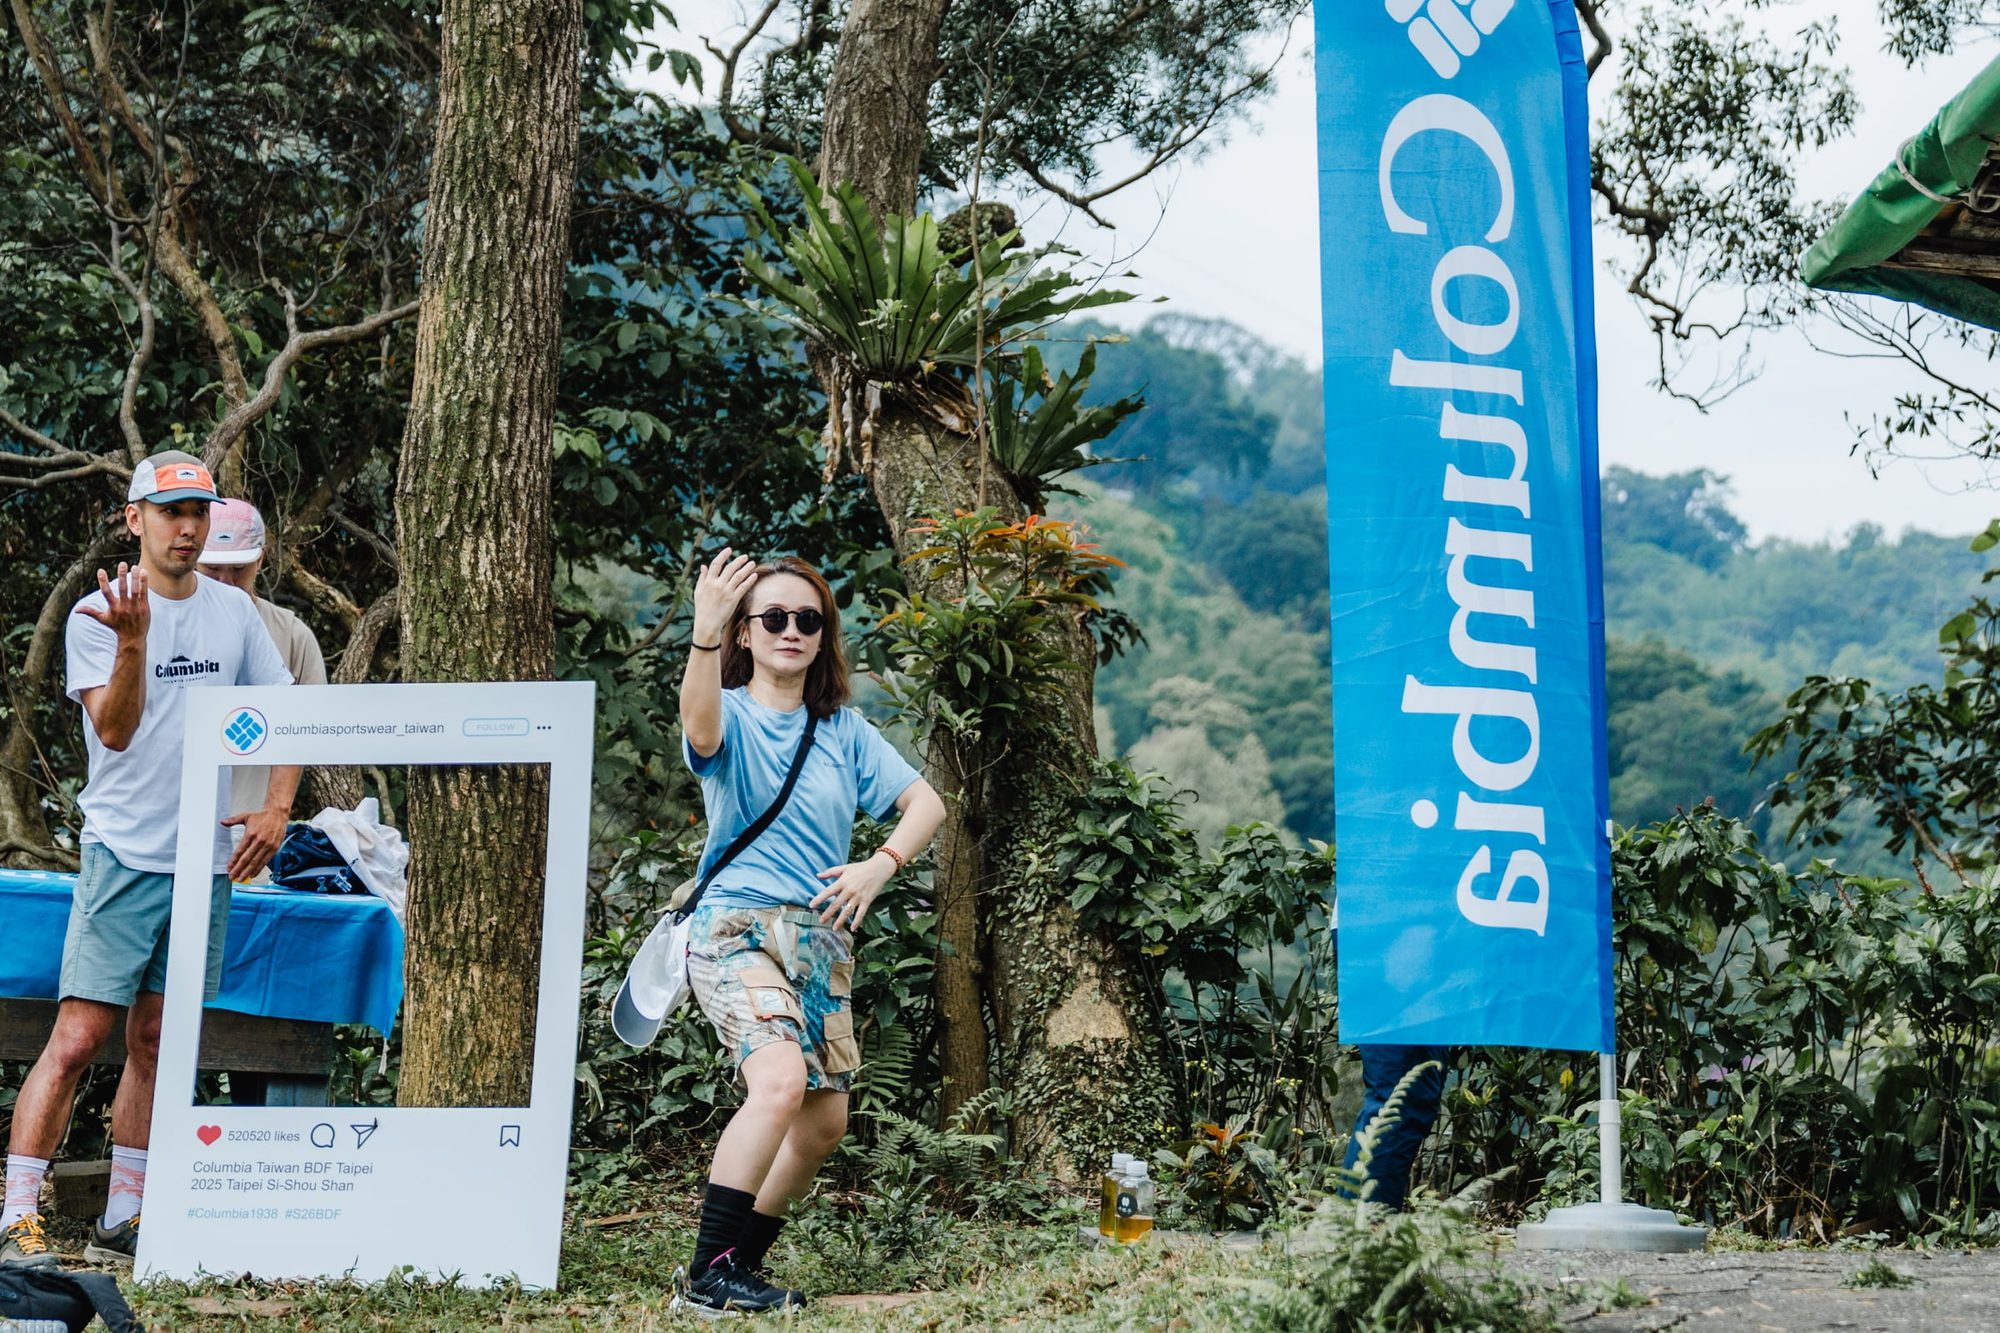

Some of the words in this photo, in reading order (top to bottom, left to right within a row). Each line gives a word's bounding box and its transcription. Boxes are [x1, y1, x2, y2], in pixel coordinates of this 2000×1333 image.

[274, 722, 444, 737] columbiasportswear_taiwan
[476, 722, 516, 732] FOLLOW
[228, 1130, 271, 1141] 520520
[274, 1130, 300, 1141] likes
[193, 1161, 252, 1173] Columbia
[256, 1161, 300, 1173] Taiwan
[304, 1162, 332, 1173] BDF
[336, 1162, 373, 1176] Taipei
[191, 1178, 222, 1190] 2025
[226, 1178, 263, 1192] Taipei
[267, 1179, 317, 1191] Si-Shou
[321, 1179, 354, 1191] Shan
[187, 1208, 278, 1219] #Columbia1938
[285, 1208, 342, 1219] #S26BDF
